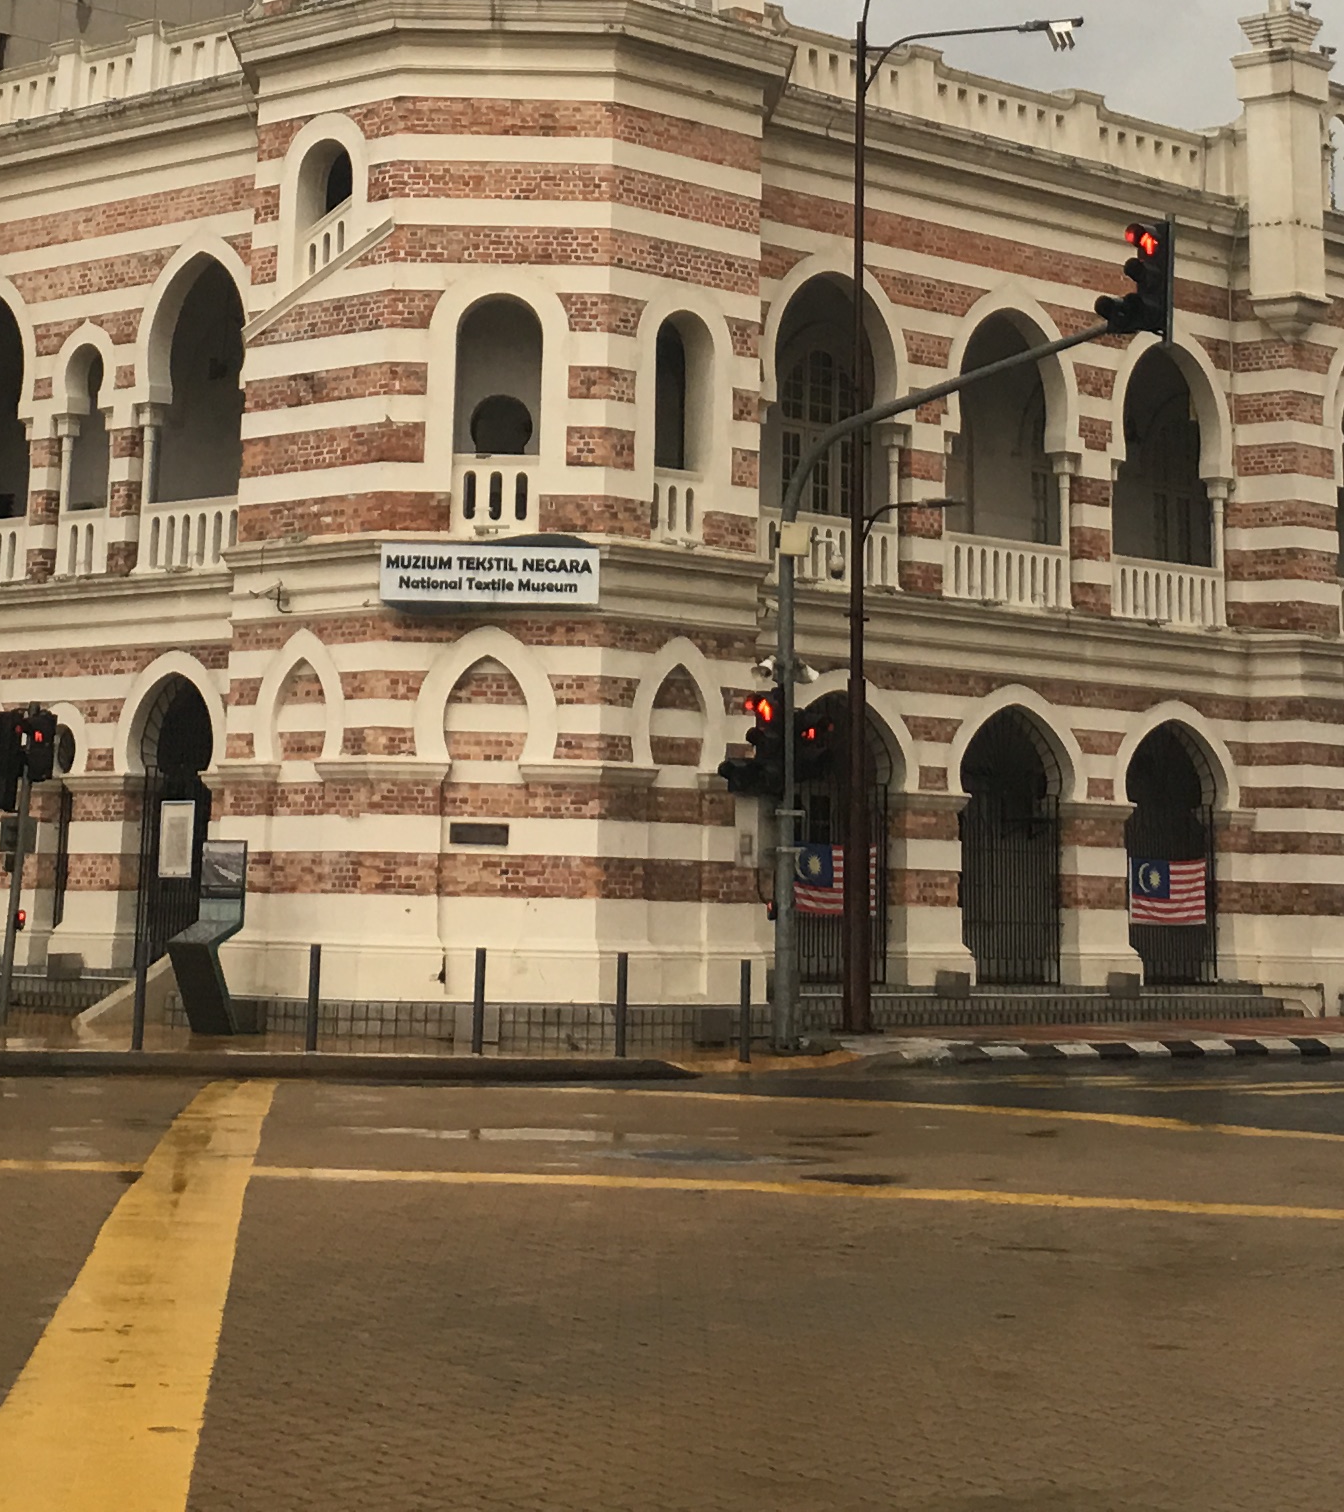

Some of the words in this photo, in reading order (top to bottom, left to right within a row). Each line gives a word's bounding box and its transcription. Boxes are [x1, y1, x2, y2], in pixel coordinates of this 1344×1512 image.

[386, 554, 452, 570] MUZIUM
[457, 556, 518, 572] TEKSTIL
[522, 558, 592, 574] NEGARA
[398, 575, 462, 590] National
[466, 577, 514, 592] Textile
[517, 578, 578, 594] Museum
